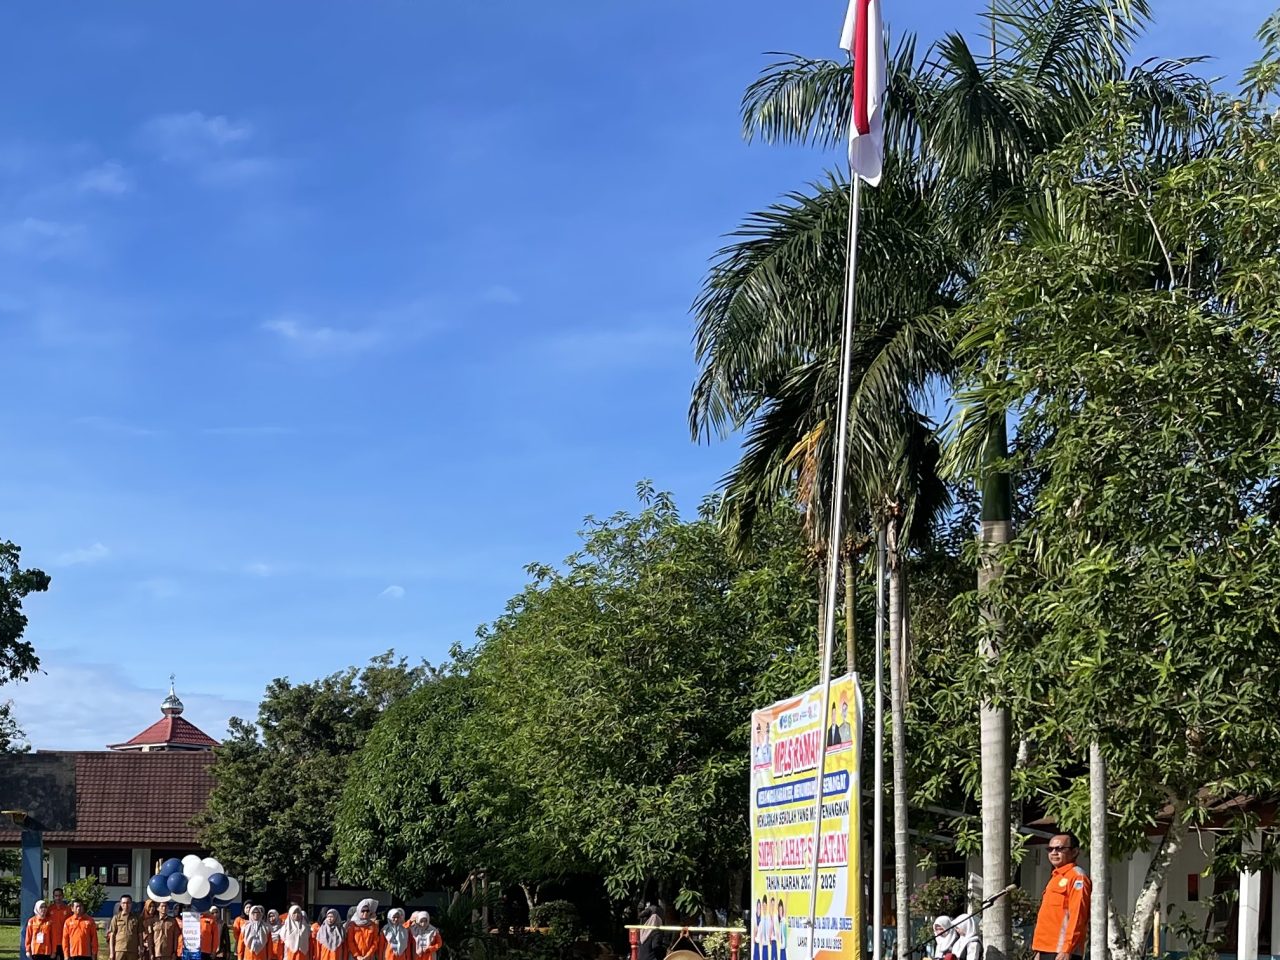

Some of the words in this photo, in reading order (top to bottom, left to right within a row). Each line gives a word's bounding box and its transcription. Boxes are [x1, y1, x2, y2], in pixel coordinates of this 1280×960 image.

[773, 737, 793, 774] MPLS
[797, 806, 809, 822] YANG
[810, 800, 849, 821] MEENANGKAN
[781, 837, 805, 866] LAHAT
[807, 833, 848, 864] SLATAN
[766, 876, 780, 891] TAHUN
[781, 876, 800, 891] AJARAN
[801, 875, 813, 890] 202
[821, 874, 837, 889] 2026
